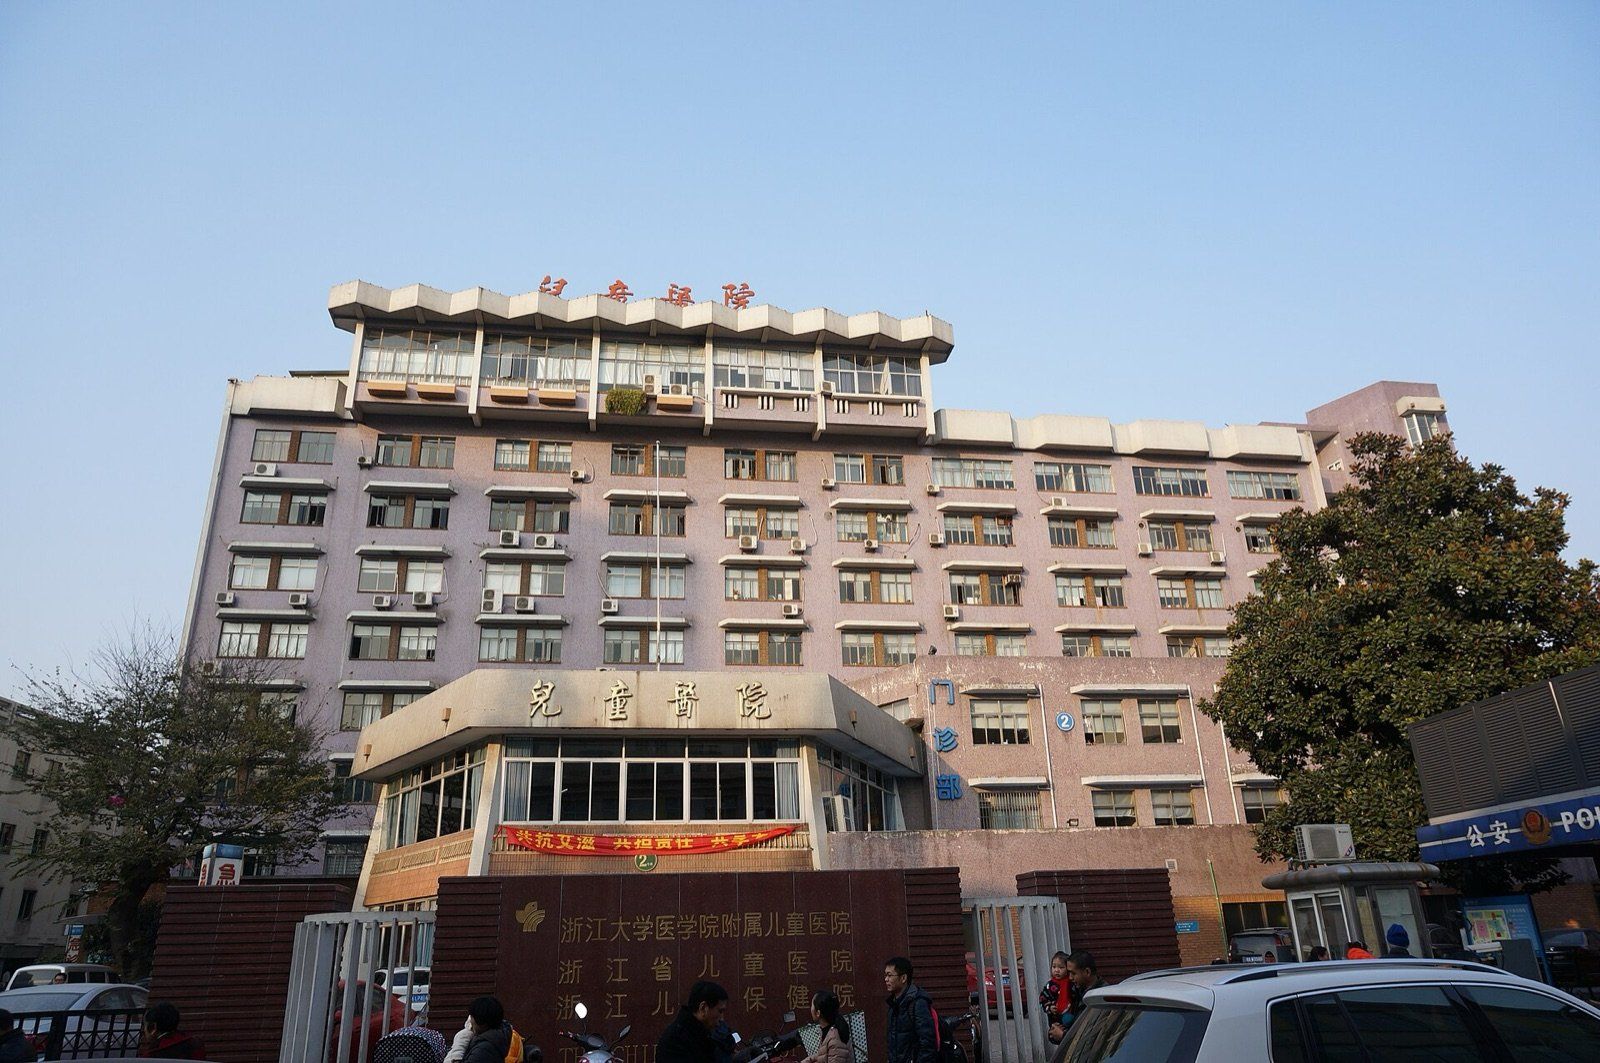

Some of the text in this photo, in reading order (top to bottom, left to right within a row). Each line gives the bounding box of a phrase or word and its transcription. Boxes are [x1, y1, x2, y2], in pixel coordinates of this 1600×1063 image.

[529, 679, 772, 721] 兒童醫院
[929, 678, 963, 800] 门诊部
[1060, 714, 1071, 729] 2
[516, 829, 595, 850] 共抗艾滋
[613, 837, 693, 850] 共担责任
[1467, 820, 1510, 847] 公安
[560, 910, 851, 944] 浙江大学医学院附属儿童医院
[558, 949, 853, 985] 浙江省儿童医院
[556, 983, 855, 1020] 浙江儿保健院
